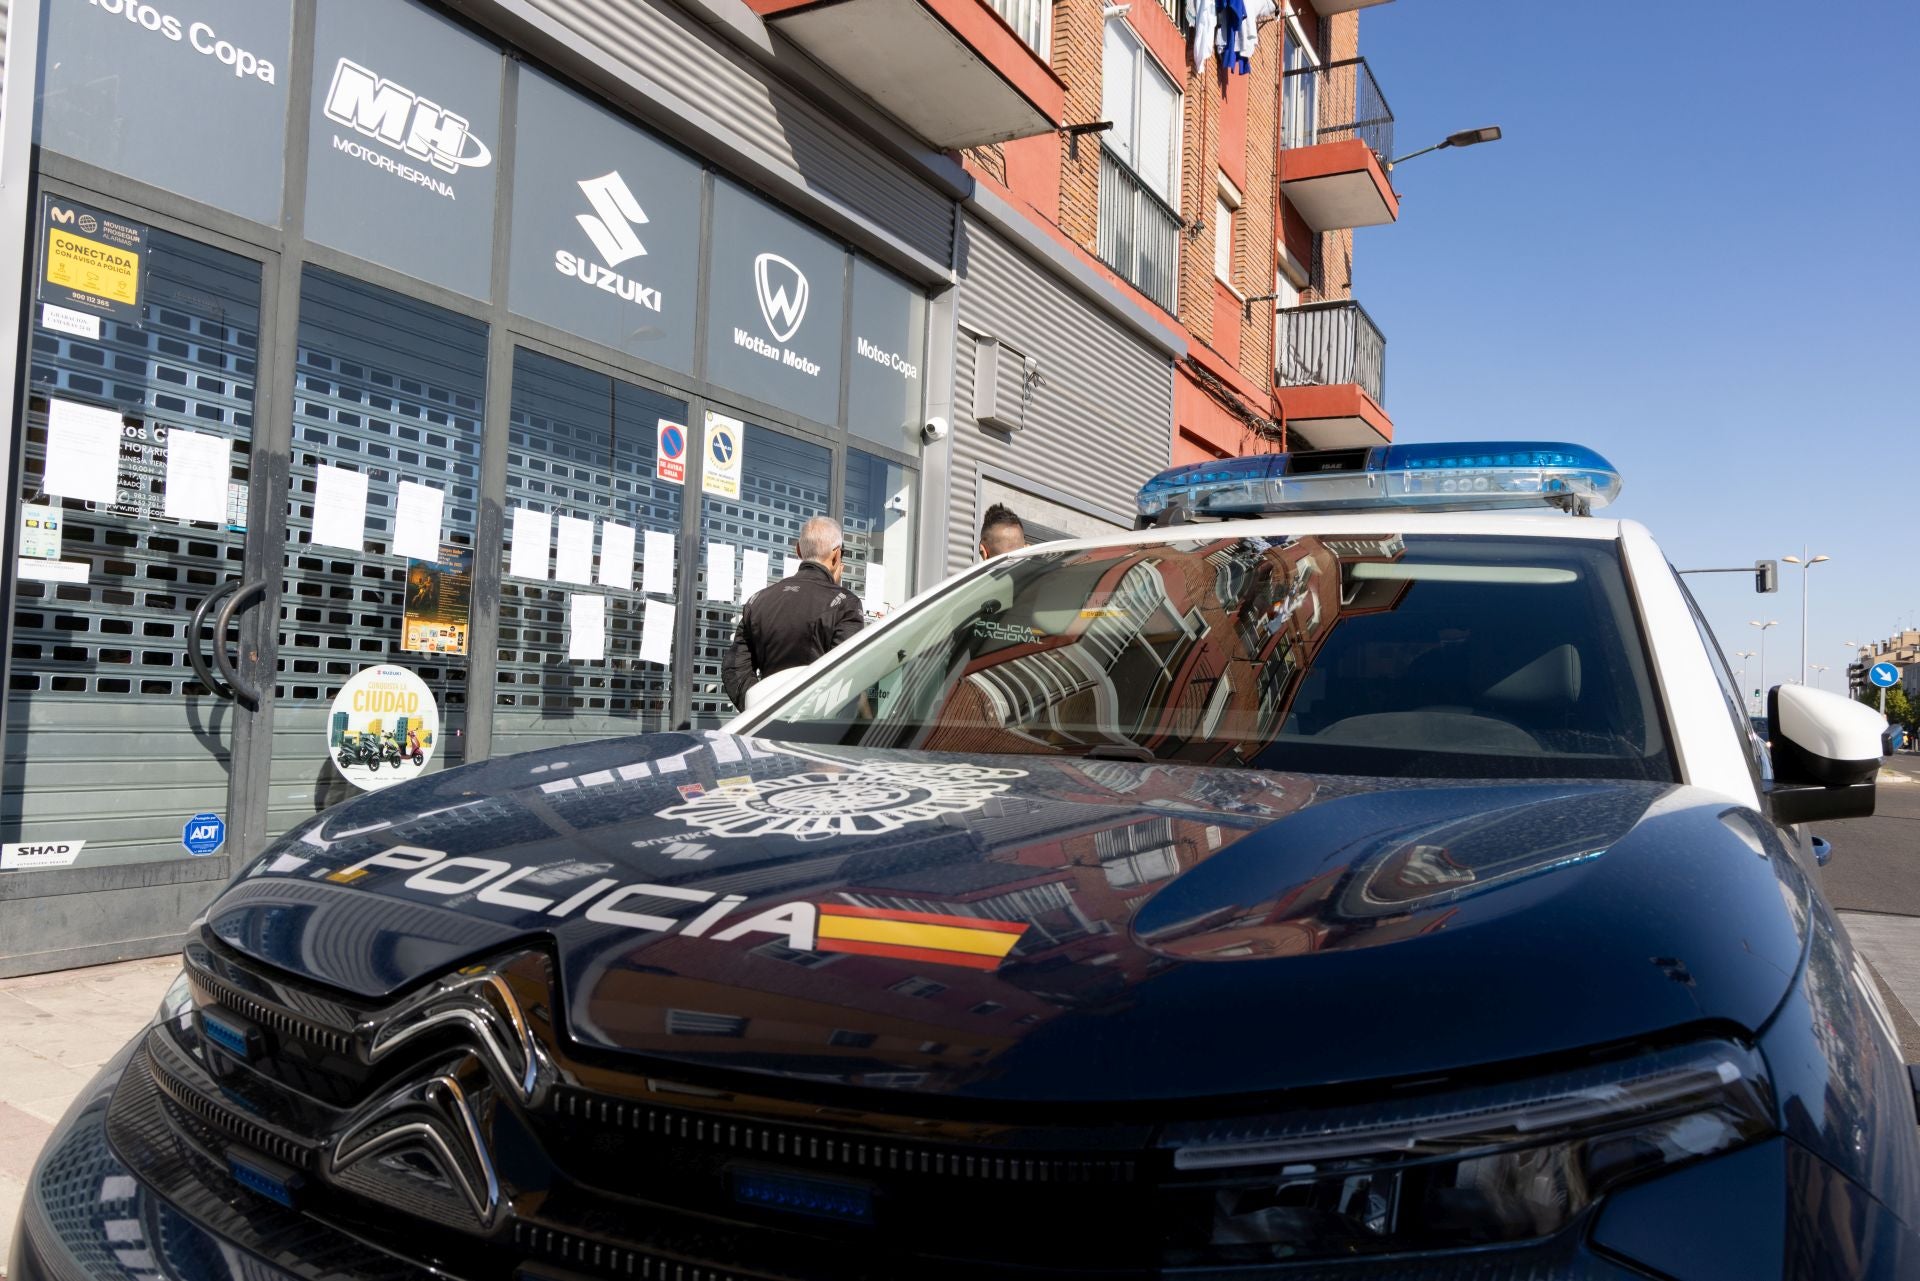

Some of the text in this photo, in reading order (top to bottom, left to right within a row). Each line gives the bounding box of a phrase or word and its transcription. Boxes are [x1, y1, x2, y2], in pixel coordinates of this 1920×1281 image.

[89, 0, 275, 85] otos Copa
[333, 135, 456, 200] MOTORHISPANIA
[103, 220, 138, 236] MOVISTAR
[103, 226, 140, 243] PROSEGUR
[102, 233, 132, 247] ALARMAS
[55, 239, 132, 269] CONECTADA
[55, 249, 72, 259] CON
[73, 254, 96, 266] AVISO
[97, 260, 102, 268] A
[555, 250, 662, 312] SUZUKI
[72, 292, 86, 300] 900
[734, 327, 821, 377] Wottan Motor
[857, 336, 917, 379] Motos Copa
[973, 629, 1043, 645] NACIONAL
[975, 620, 1033, 635] POLICIA
[353, 688, 419, 713] CIUDAD
[190, 825, 219, 840] ADT
[17, 845, 70, 856] SHAD
[341, 845, 816, 951] POLICIA
